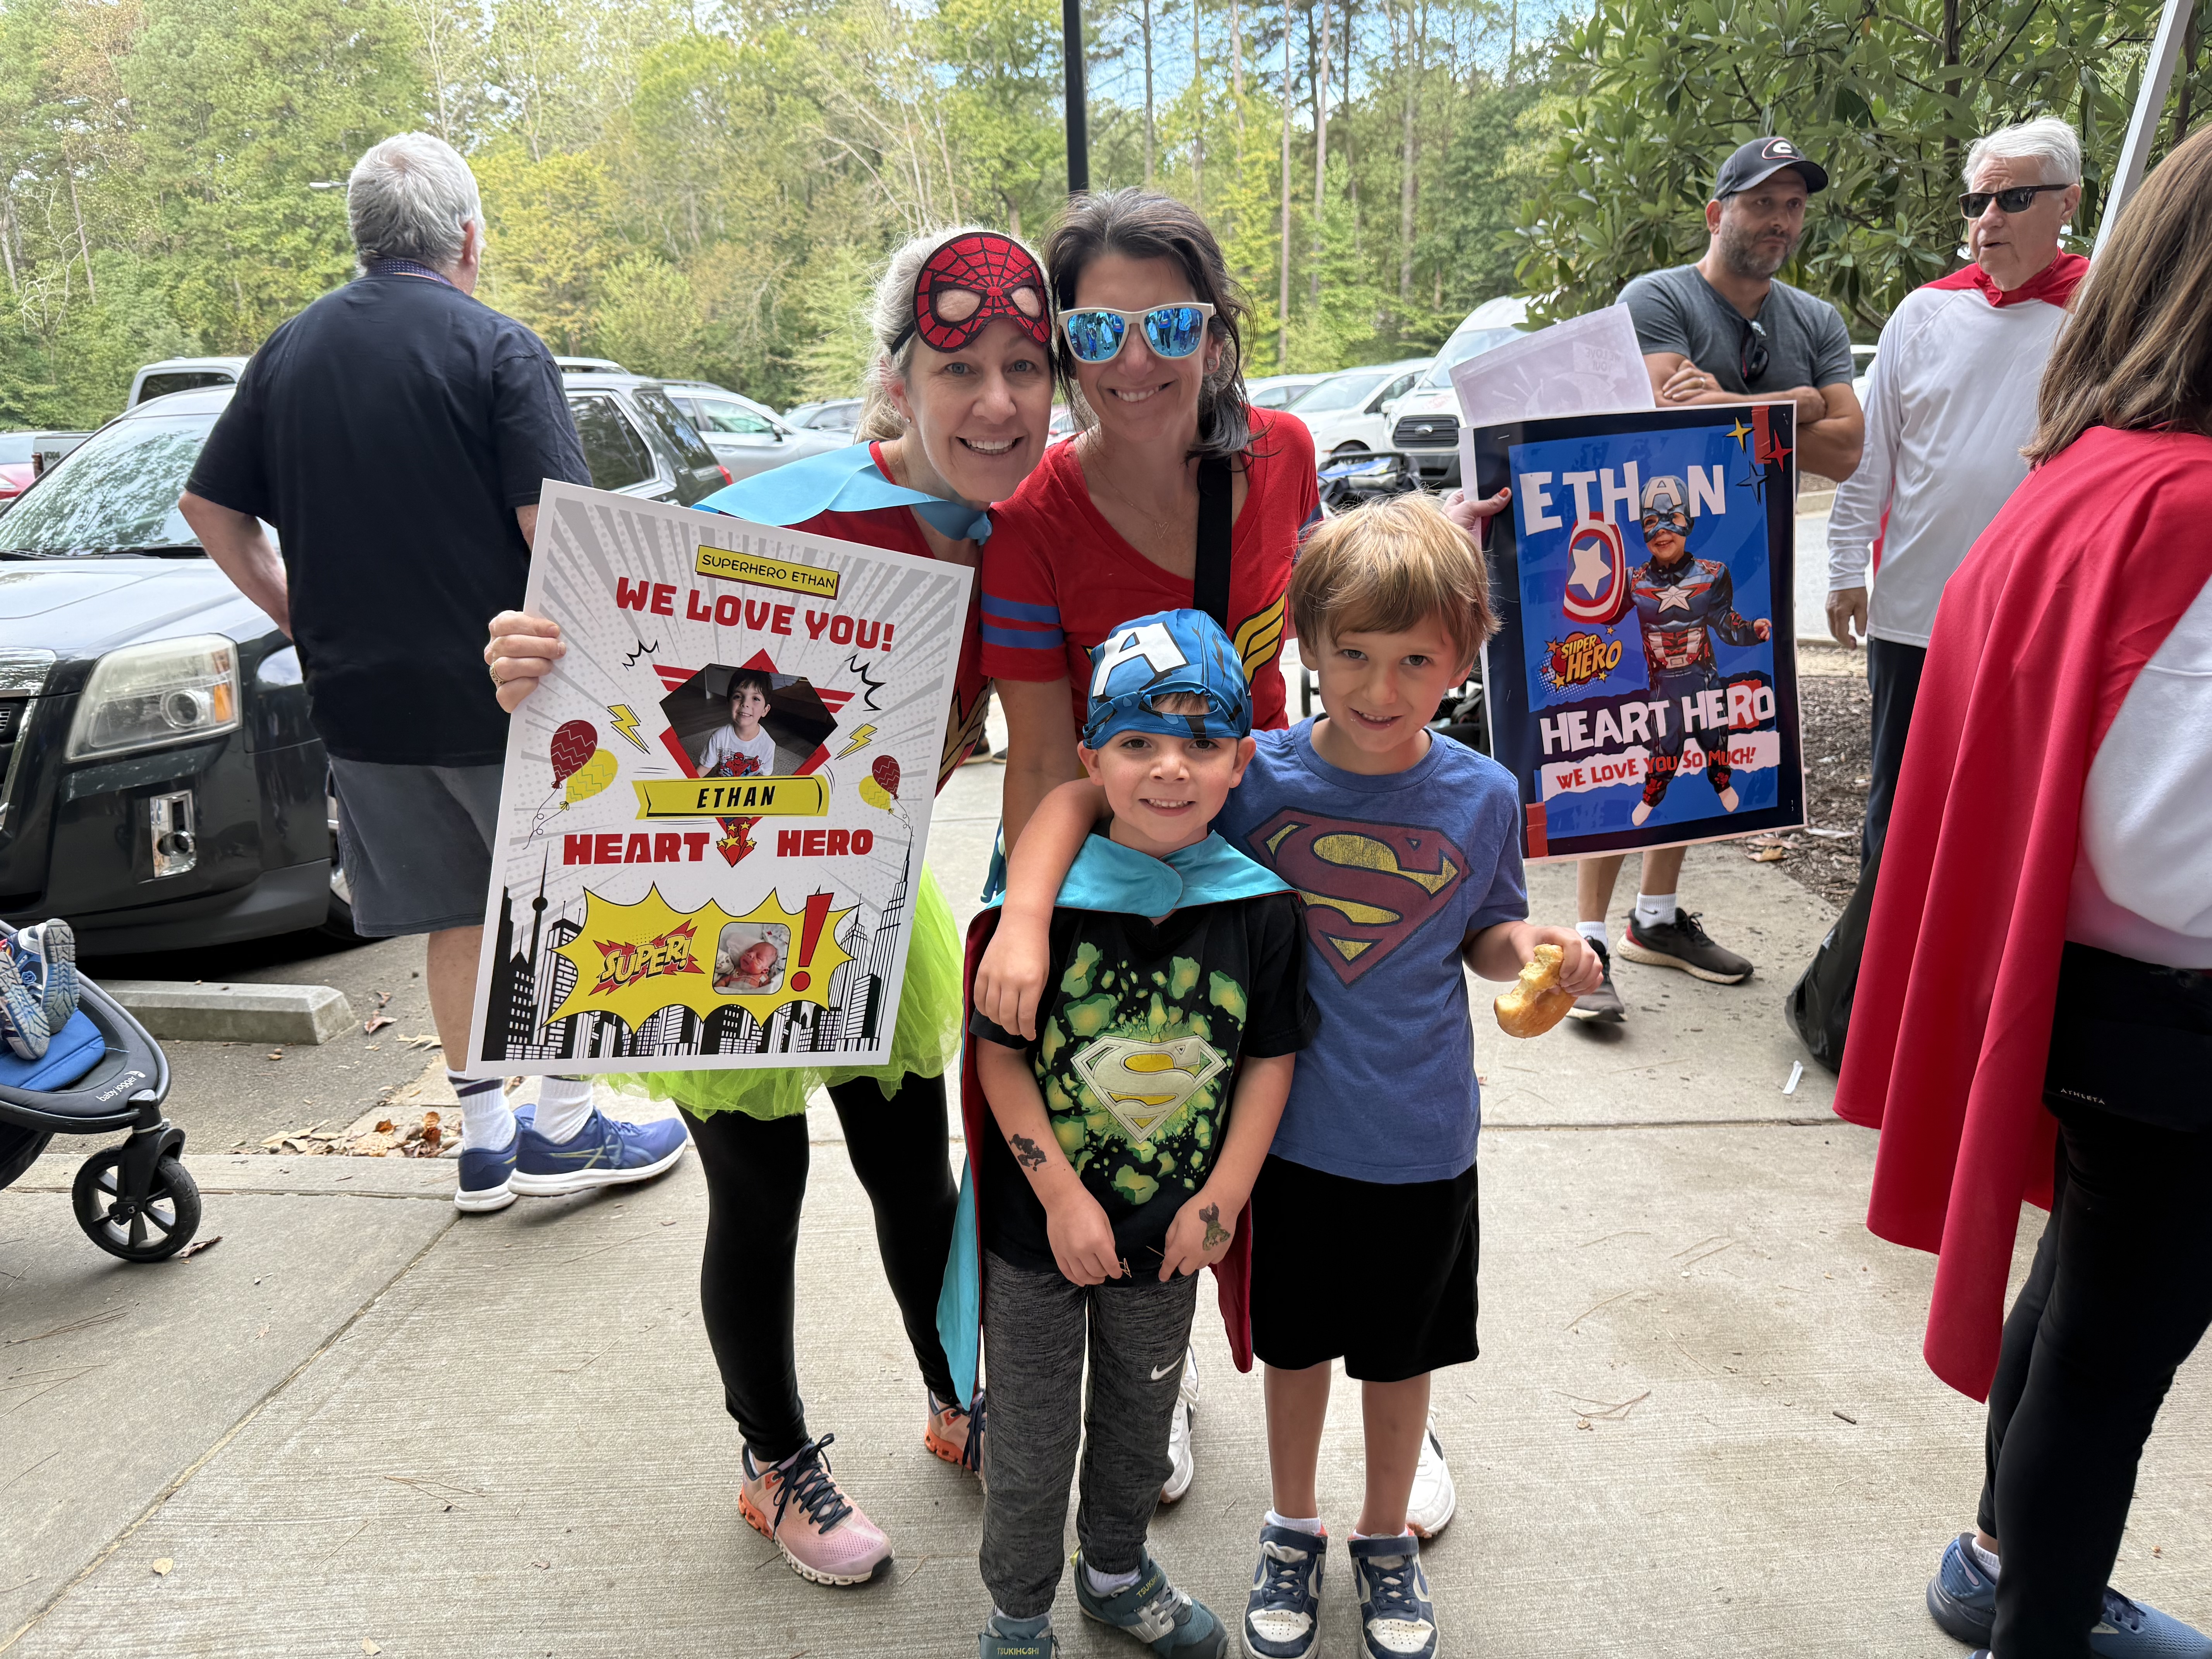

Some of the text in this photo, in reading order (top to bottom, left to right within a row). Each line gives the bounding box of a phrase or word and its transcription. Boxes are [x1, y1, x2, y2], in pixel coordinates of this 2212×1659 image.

[1773, 142, 1792, 153] G
[1519, 460, 1726, 536] ETHAN
[702, 554, 835, 589] SUPERHERO ETHAN
[616, 576, 895, 652] WE LOVE YOU!
[1561, 634, 1597, 659] SUPER
[1566, 640, 1621, 683] HERO
[1539, 685, 1776, 754] HEART HERO
[1556, 747, 1756, 790] WE LOVE YOU SO MUCH!
[697, 785, 775, 809] ETHAN
[563, 829, 873, 865] HEART HERO
[599, 934, 692, 984] SUPER!
[95, 1076, 136, 1101] baby jogger
[2061, 1088, 2105, 1105] ATHLETA
